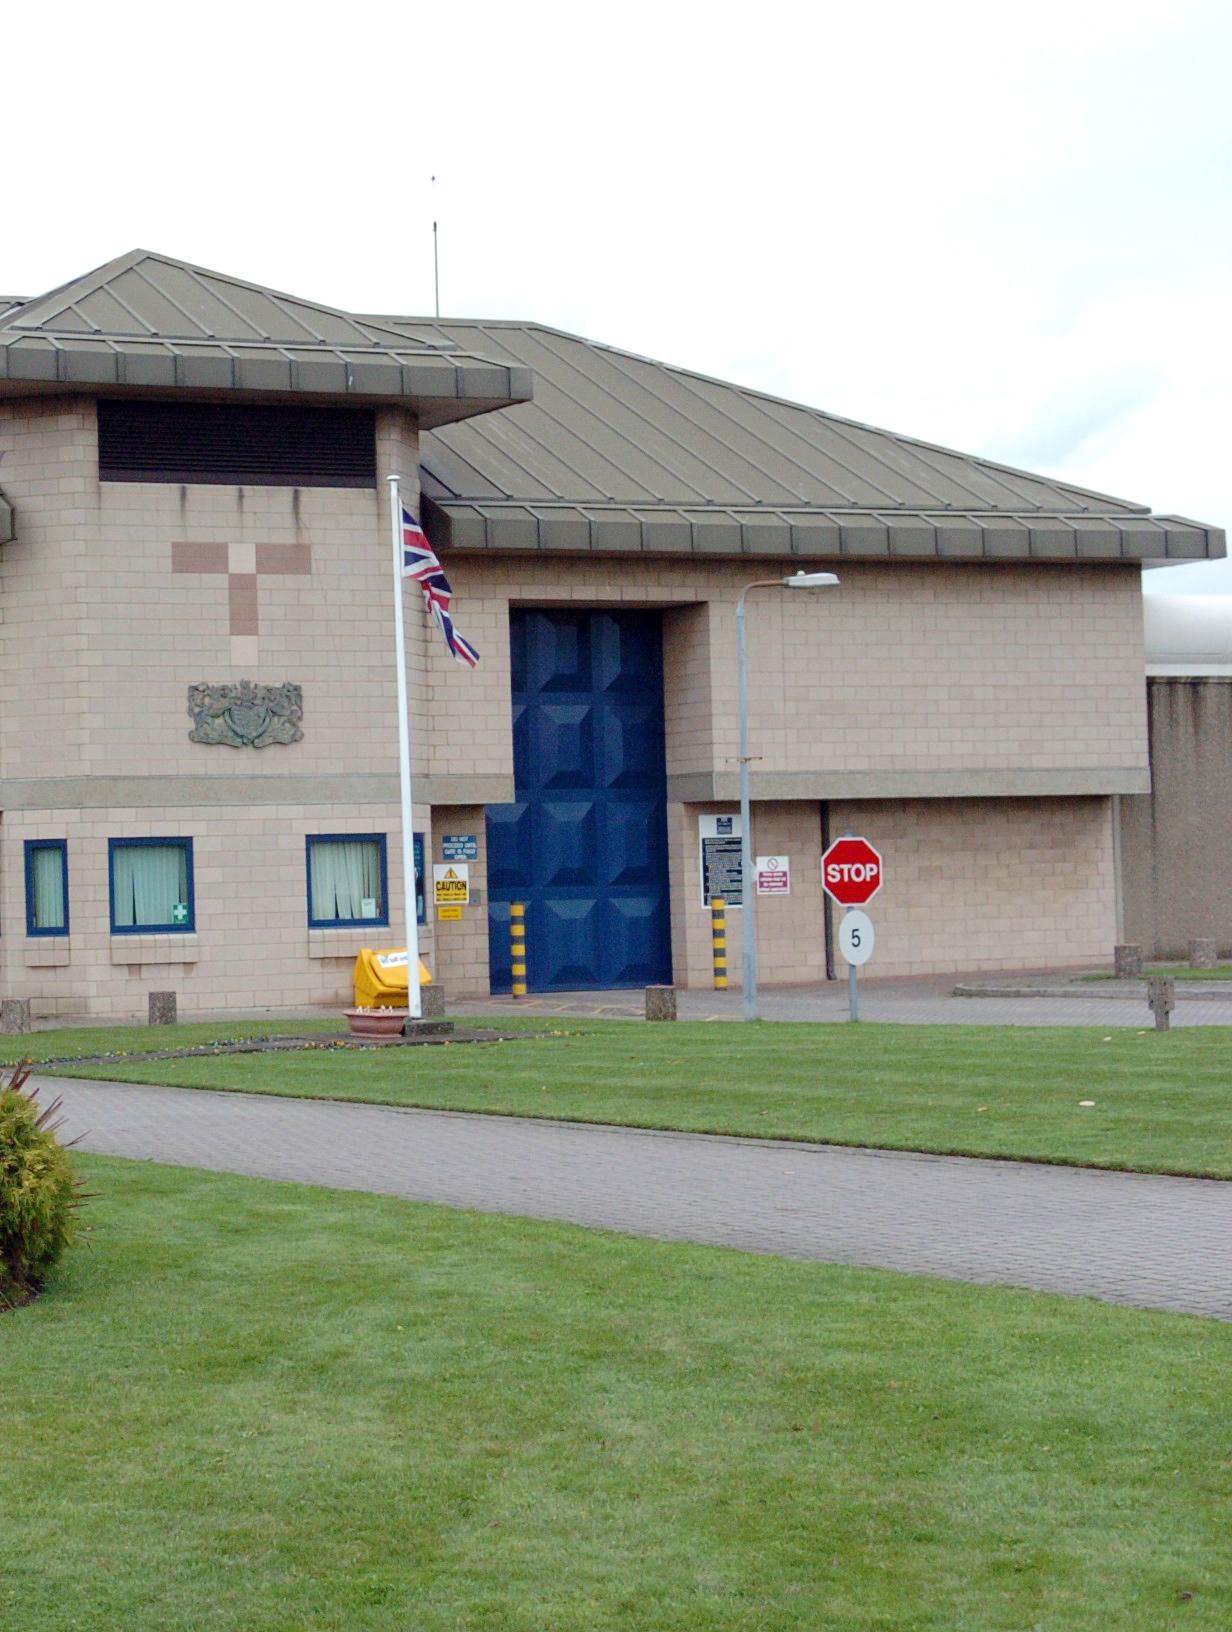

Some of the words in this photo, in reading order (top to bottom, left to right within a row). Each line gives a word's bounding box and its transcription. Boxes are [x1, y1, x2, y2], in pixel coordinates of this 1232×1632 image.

[827, 863, 878, 883] STOP
[436, 881, 467, 891] CAUTION
[851, 928, 861, 947] 5
